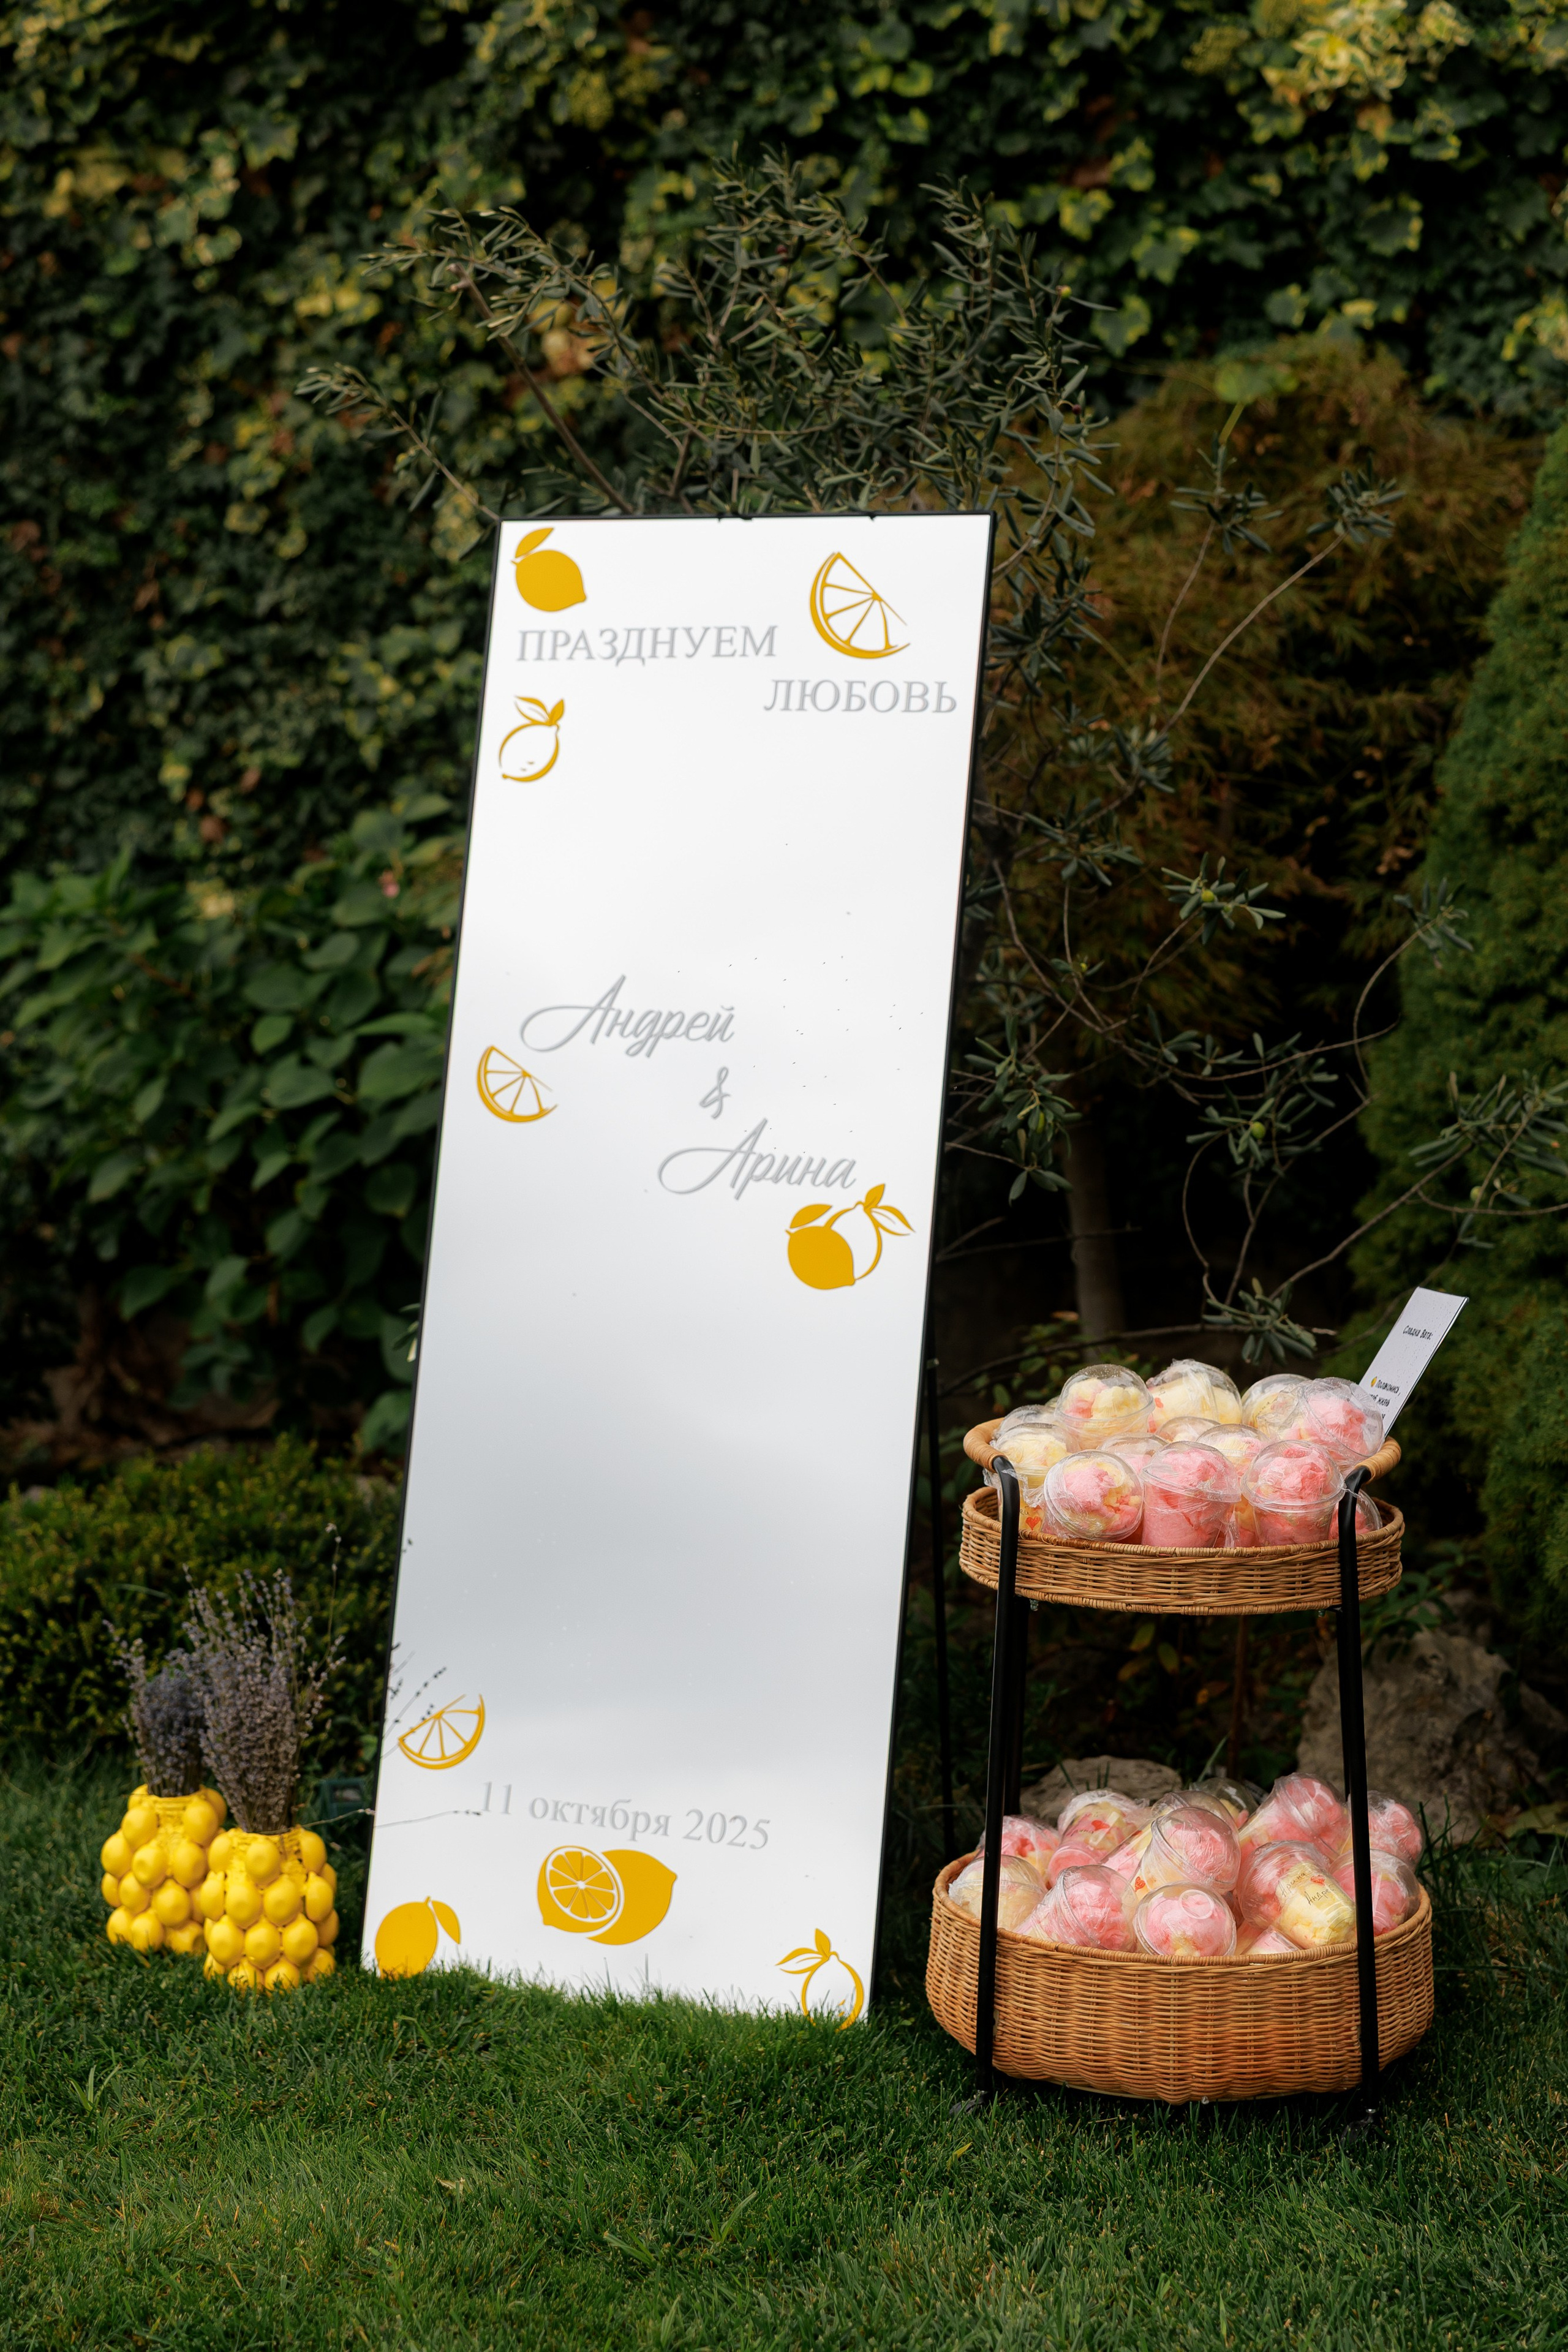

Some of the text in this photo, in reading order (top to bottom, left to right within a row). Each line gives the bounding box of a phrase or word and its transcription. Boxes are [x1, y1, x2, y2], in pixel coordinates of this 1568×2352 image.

[516, 624, 778, 668] ПРАЗДНУЕМ
[763, 679, 958, 714] ЛЮБОВЬ
[519, 974, 736, 1058] Андрей
[698, 1066, 731, 1120] &
[657, 1118, 857, 1201] Арина
[481, 1781, 771, 1850] 11 октября 2025
